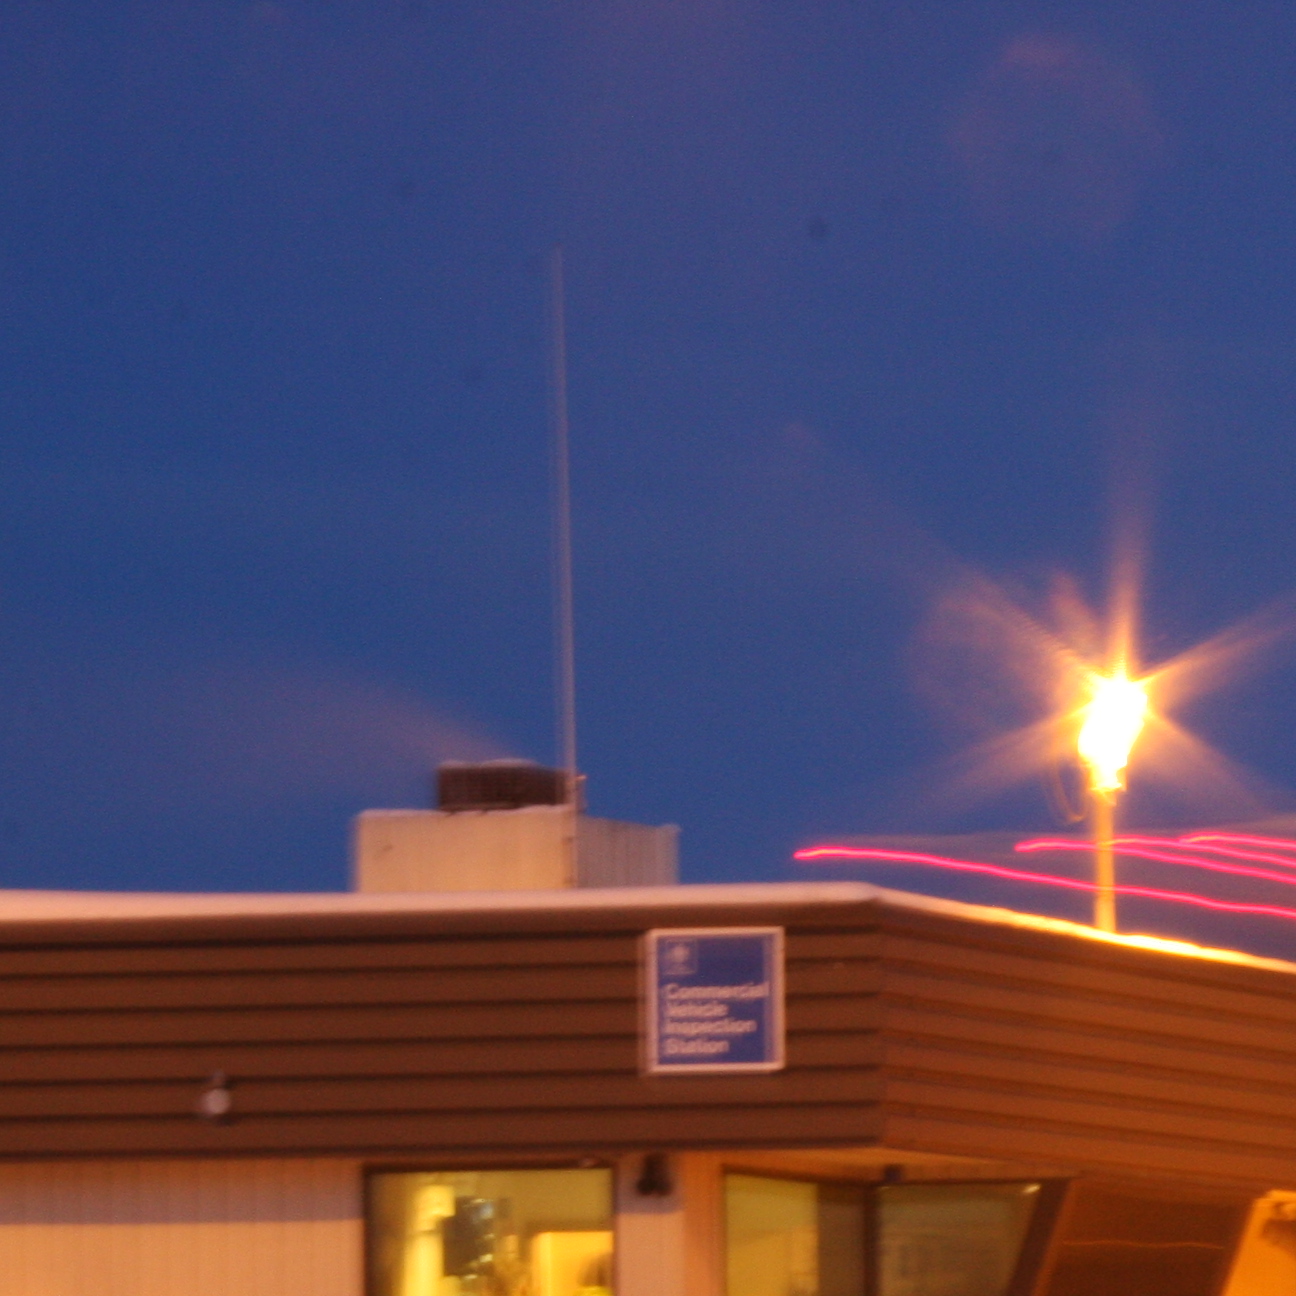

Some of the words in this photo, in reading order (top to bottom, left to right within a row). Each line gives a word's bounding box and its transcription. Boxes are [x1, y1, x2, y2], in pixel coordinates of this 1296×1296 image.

[661, 981, 770, 1000] Commercial
[661, 1000, 729, 1018] Vehicle
[661, 1017, 758, 1036] Inspection
[661, 1037, 730, 1055] Station
